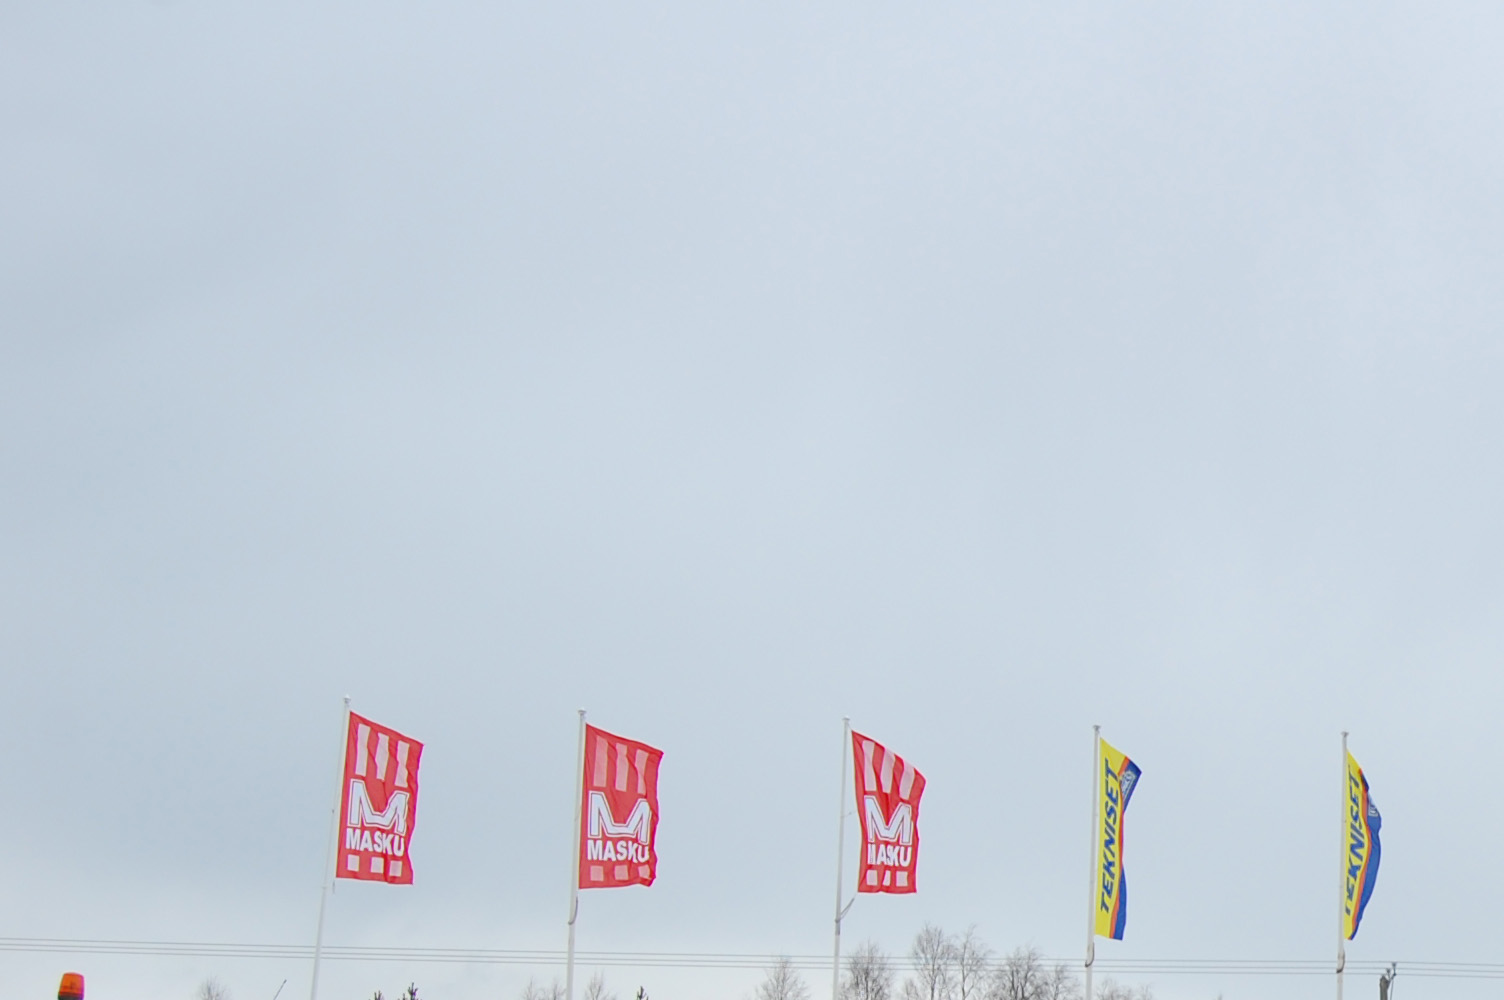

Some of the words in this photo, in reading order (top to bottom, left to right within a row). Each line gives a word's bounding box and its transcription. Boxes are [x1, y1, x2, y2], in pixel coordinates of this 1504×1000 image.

[346, 828, 404, 856] MASKU
[1100, 757, 1120, 914] TEKNISET
[587, 839, 649, 863] MASKU
[868, 843, 912, 867] MASKU
